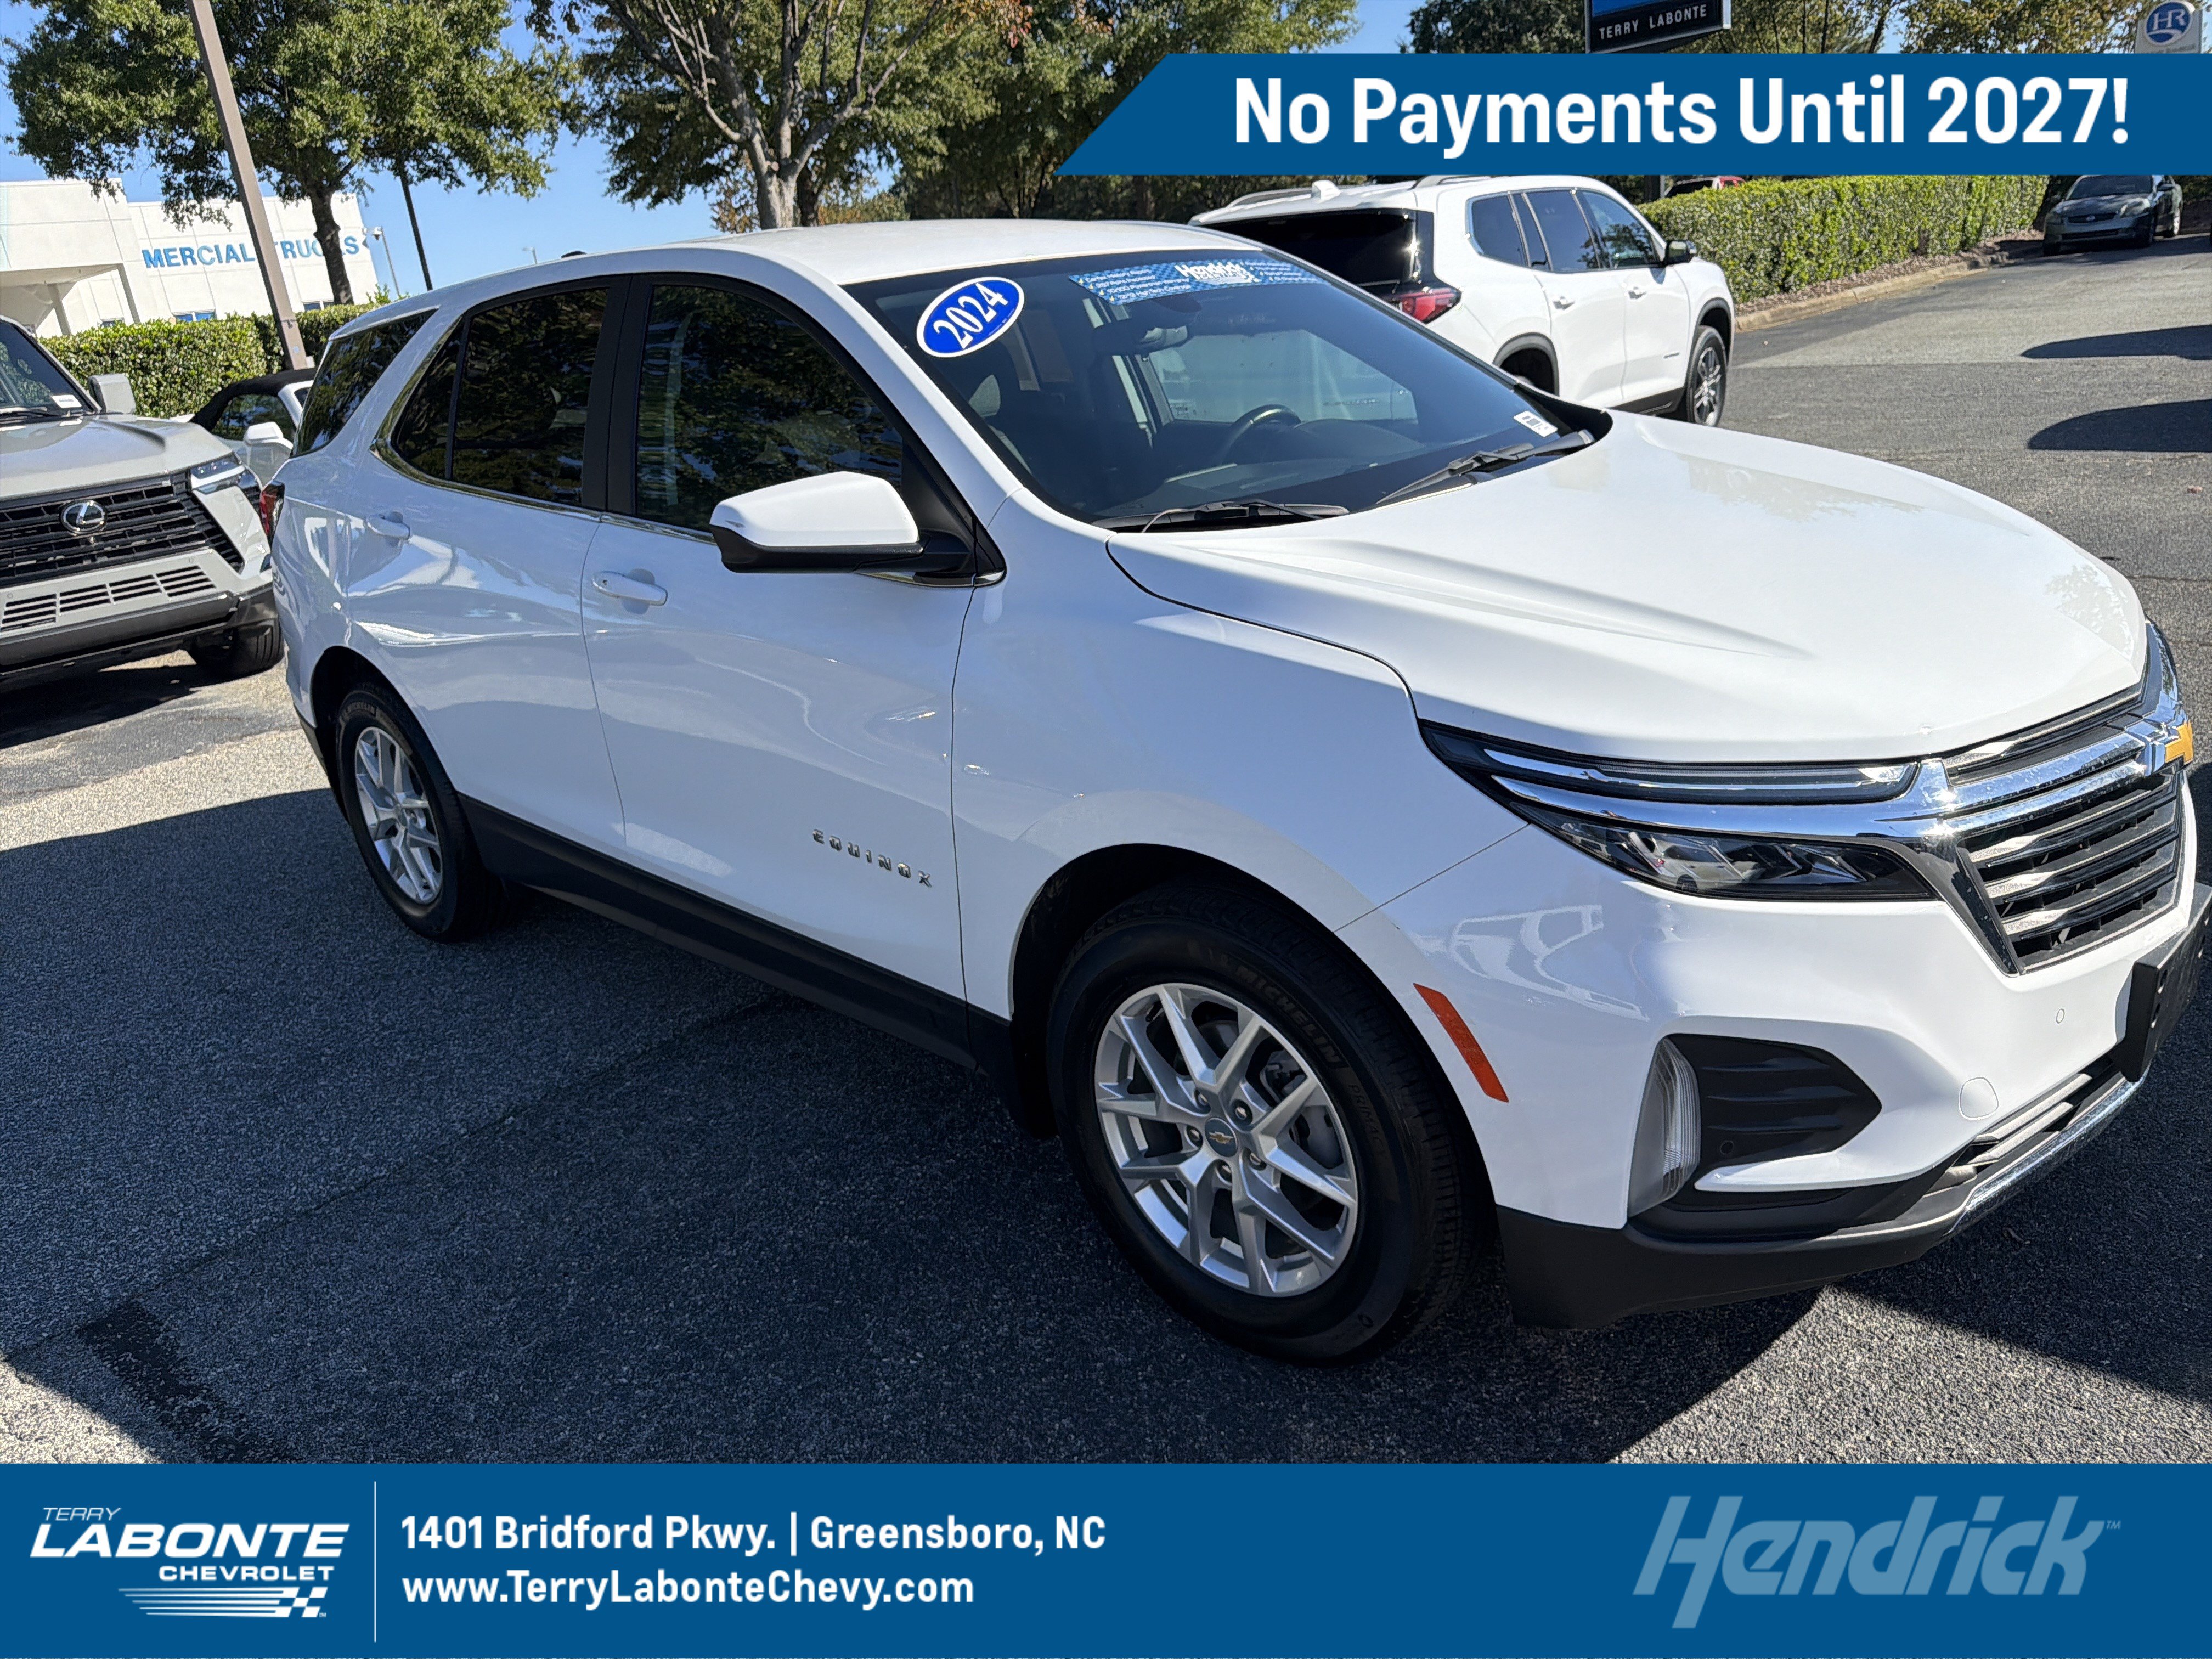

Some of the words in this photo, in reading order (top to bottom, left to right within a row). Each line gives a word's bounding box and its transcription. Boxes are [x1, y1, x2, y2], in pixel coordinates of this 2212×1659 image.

[1599, 19, 1639, 40] TERRY
[1649, 4, 1707, 29] LABONTE
[274, 236, 360, 259] RUCS
[933, 283, 1008, 349] 2024
[812, 829, 932, 888] EQUINOX
[1235, 966, 1341, 1063] MICHELIN
